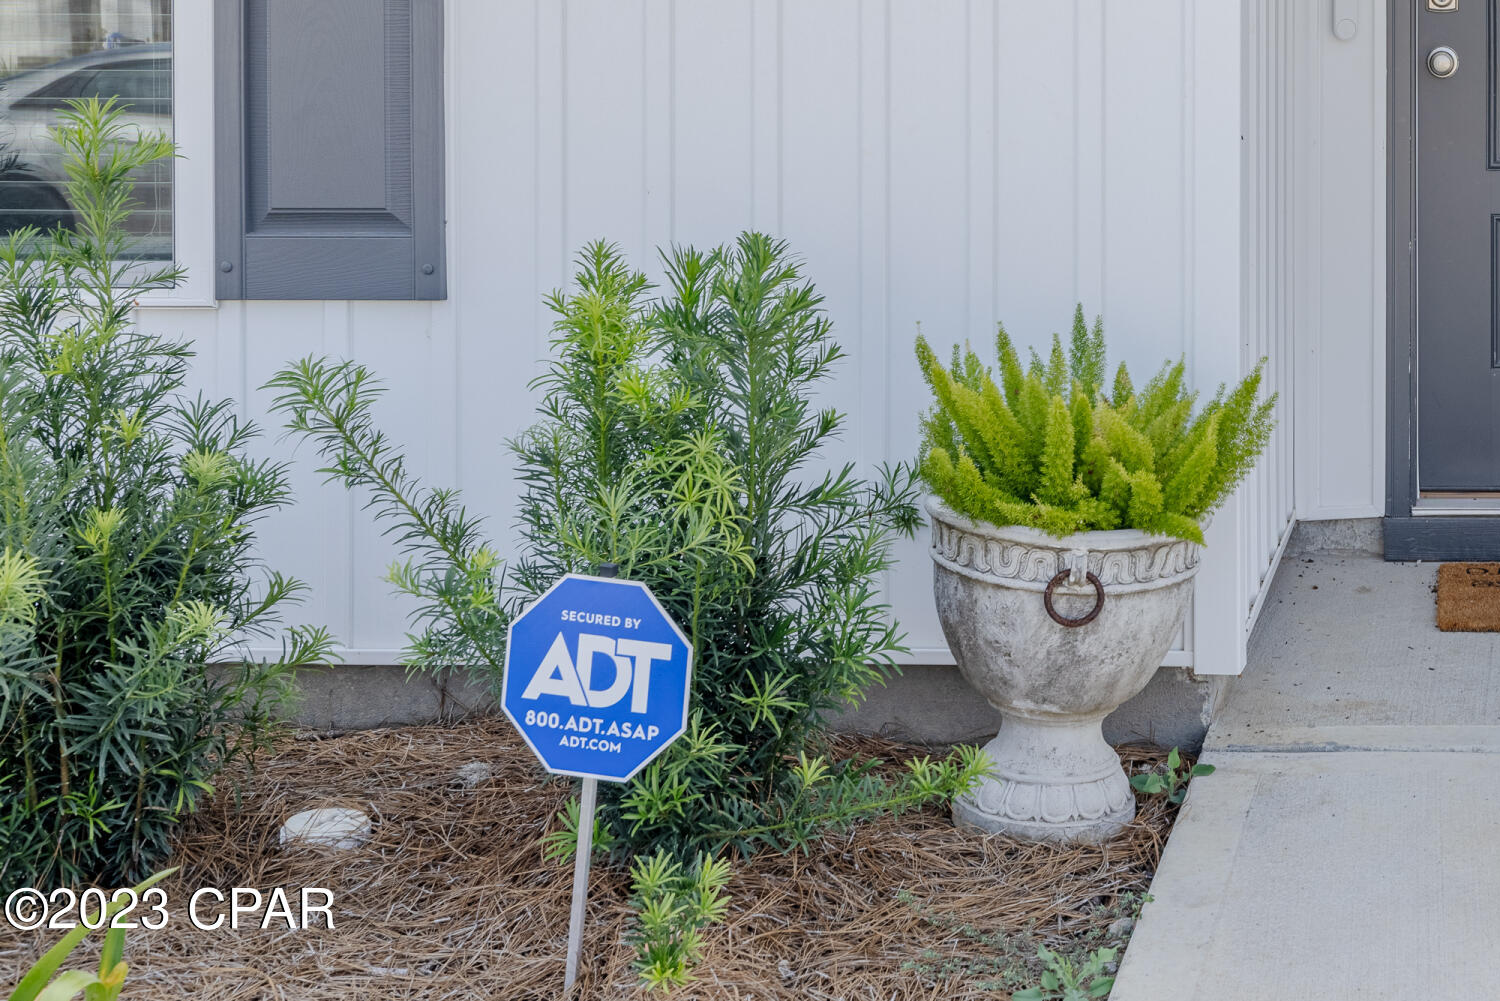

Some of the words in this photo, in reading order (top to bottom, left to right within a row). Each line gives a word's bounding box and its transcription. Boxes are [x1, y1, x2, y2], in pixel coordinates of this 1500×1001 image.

[561, 609, 621, 627] SECURED
[625, 616, 642, 630] BY
[521, 631, 673, 714] ADT
[525, 709, 659, 741] 800.ADT.ASAP
[559, 735, 621, 753] ADT.COM
